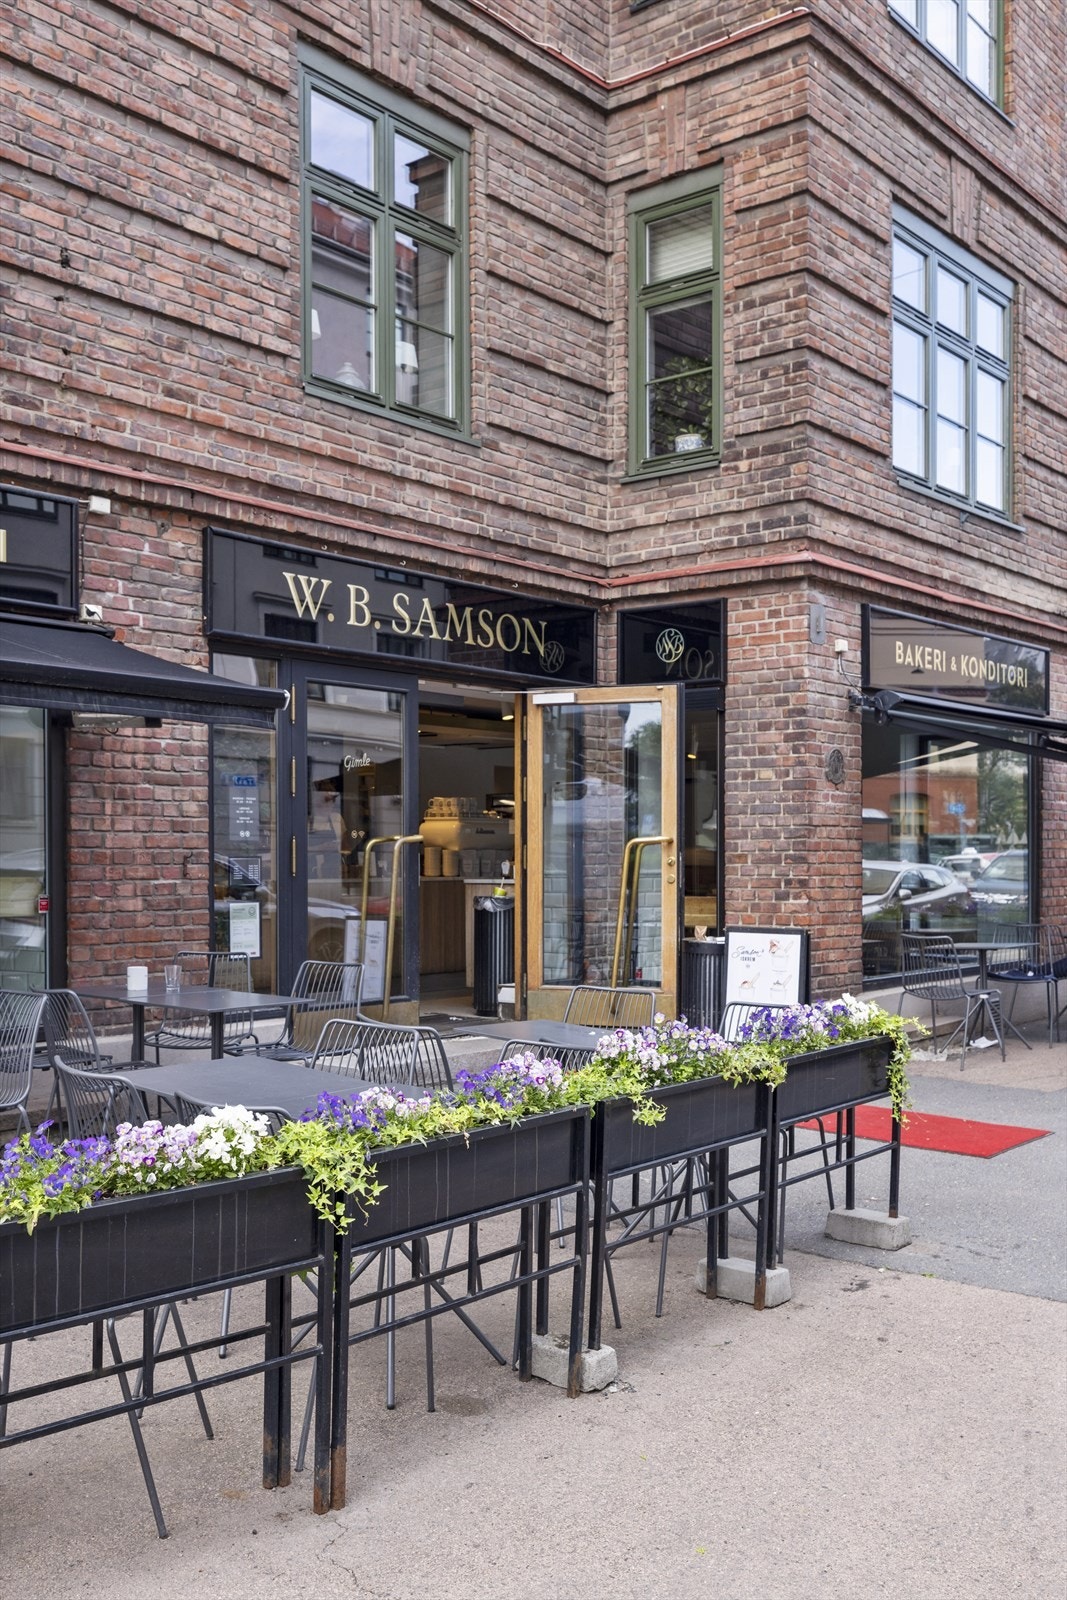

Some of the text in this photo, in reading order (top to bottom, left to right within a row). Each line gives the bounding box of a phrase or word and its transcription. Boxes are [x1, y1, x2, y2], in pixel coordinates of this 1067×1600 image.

[283, 571, 547, 655] W. B. SAMSON
[895, 640, 1028, 688] BAKERI & KONDITORI
[344, 752, 371, 771] Gimle
